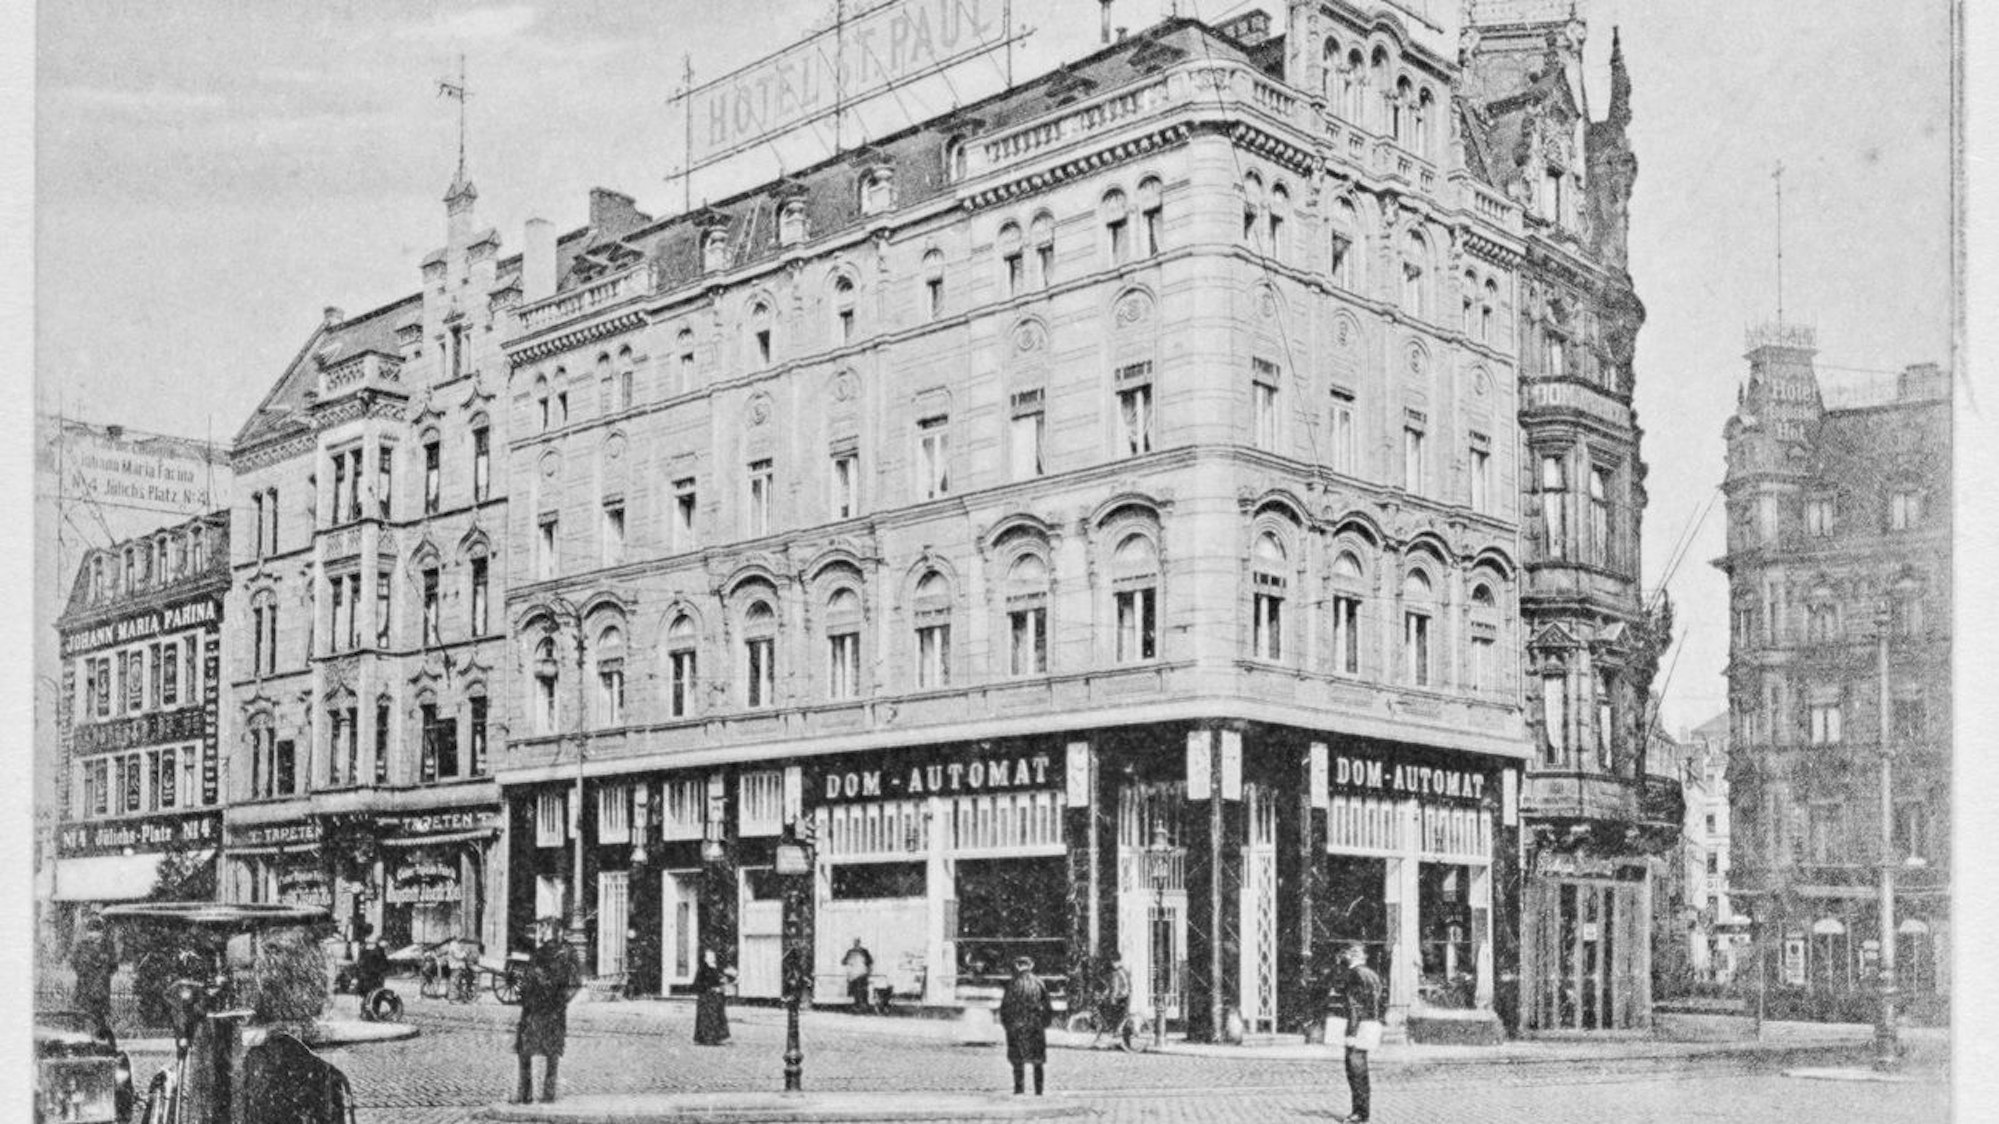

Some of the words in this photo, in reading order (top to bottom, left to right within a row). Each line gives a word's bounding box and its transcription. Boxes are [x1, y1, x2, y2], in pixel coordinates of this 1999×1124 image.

[66, 622, 114, 652] JOHANN
[118, 614, 160, 641] MARIA
[164, 600, 215, 630] FARINA
